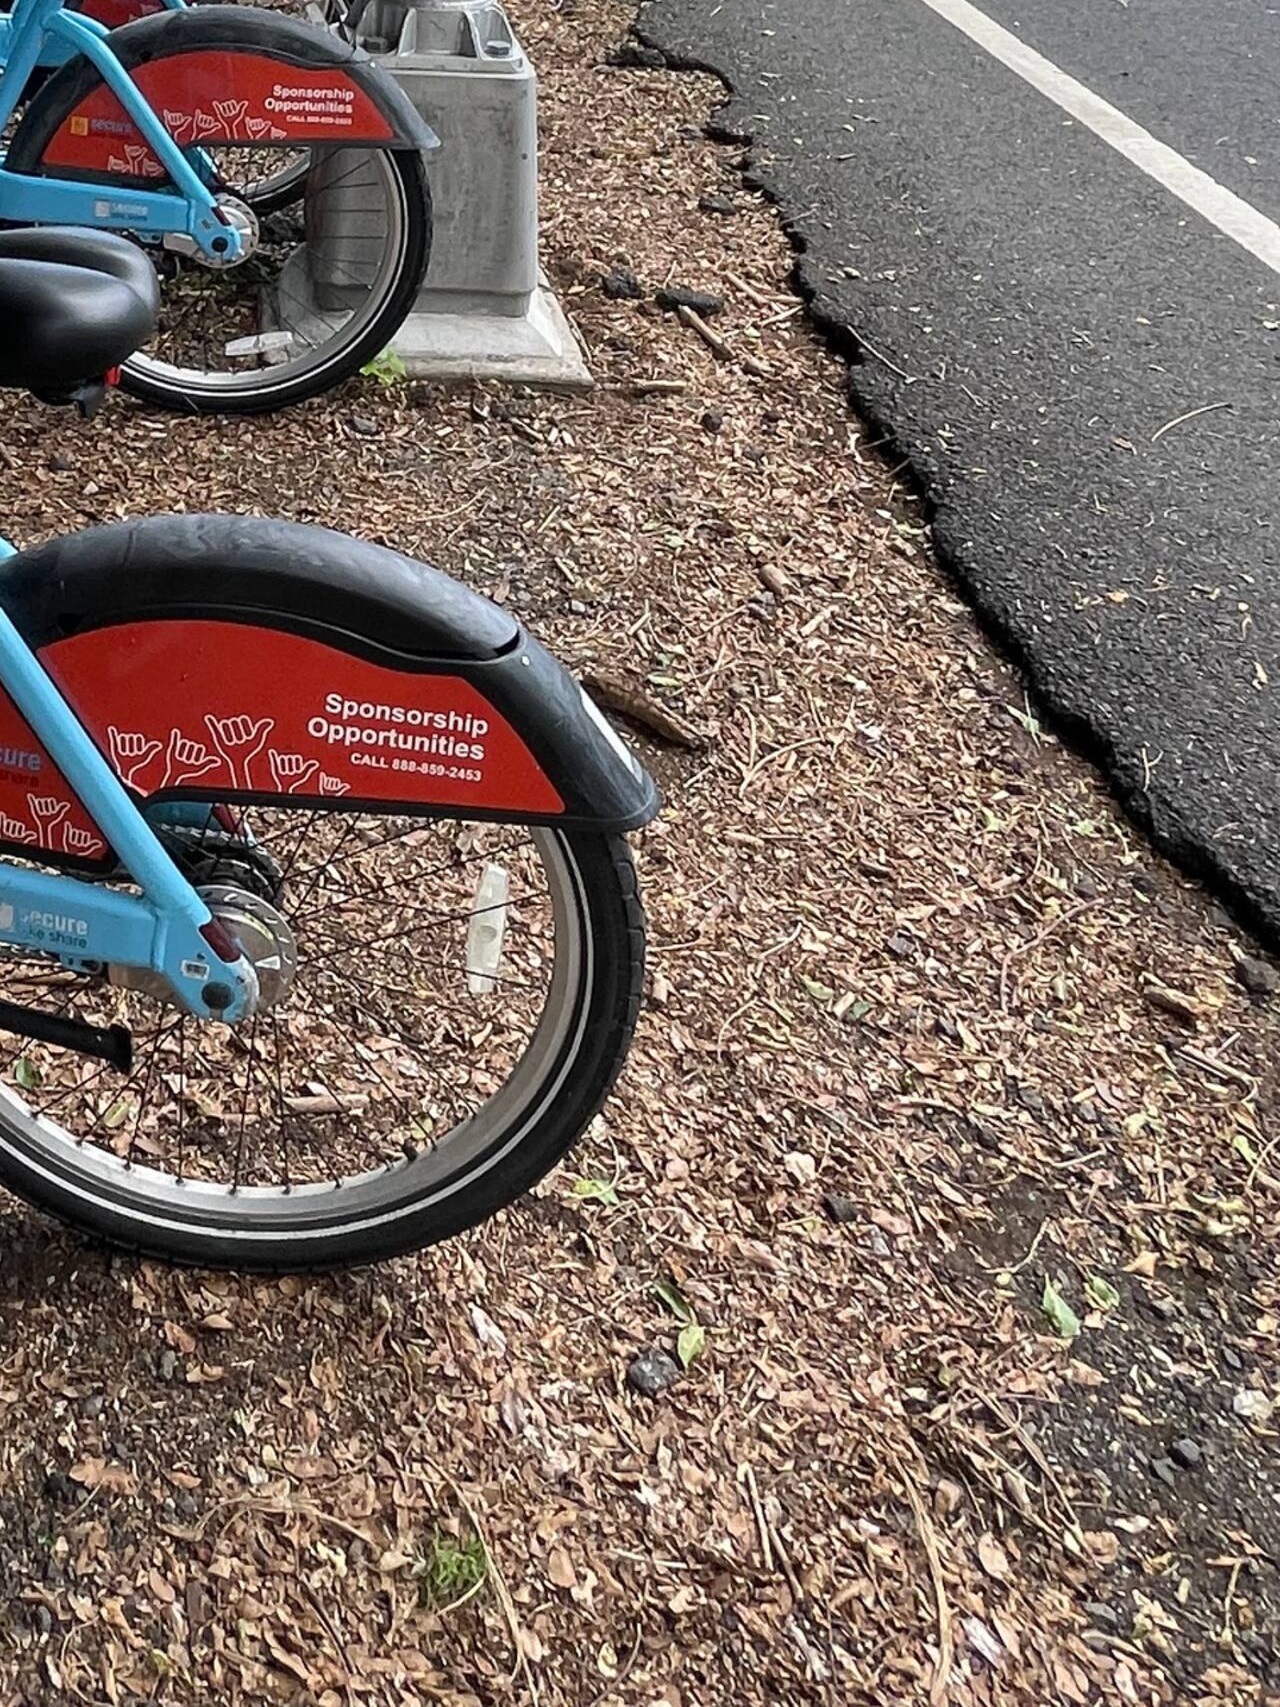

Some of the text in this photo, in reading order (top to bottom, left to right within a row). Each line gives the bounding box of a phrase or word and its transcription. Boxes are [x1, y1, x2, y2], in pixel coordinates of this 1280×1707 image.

[273, 84, 355, 102] Sponsorship
[264, 97, 353, 114] Opportunities
[325, 693, 489, 739] Sponsorship
[307, 716, 486, 761] Opportunities
[350, 751, 483, 782] CALL 888-859-2453
[49, 931, 89, 949] share
